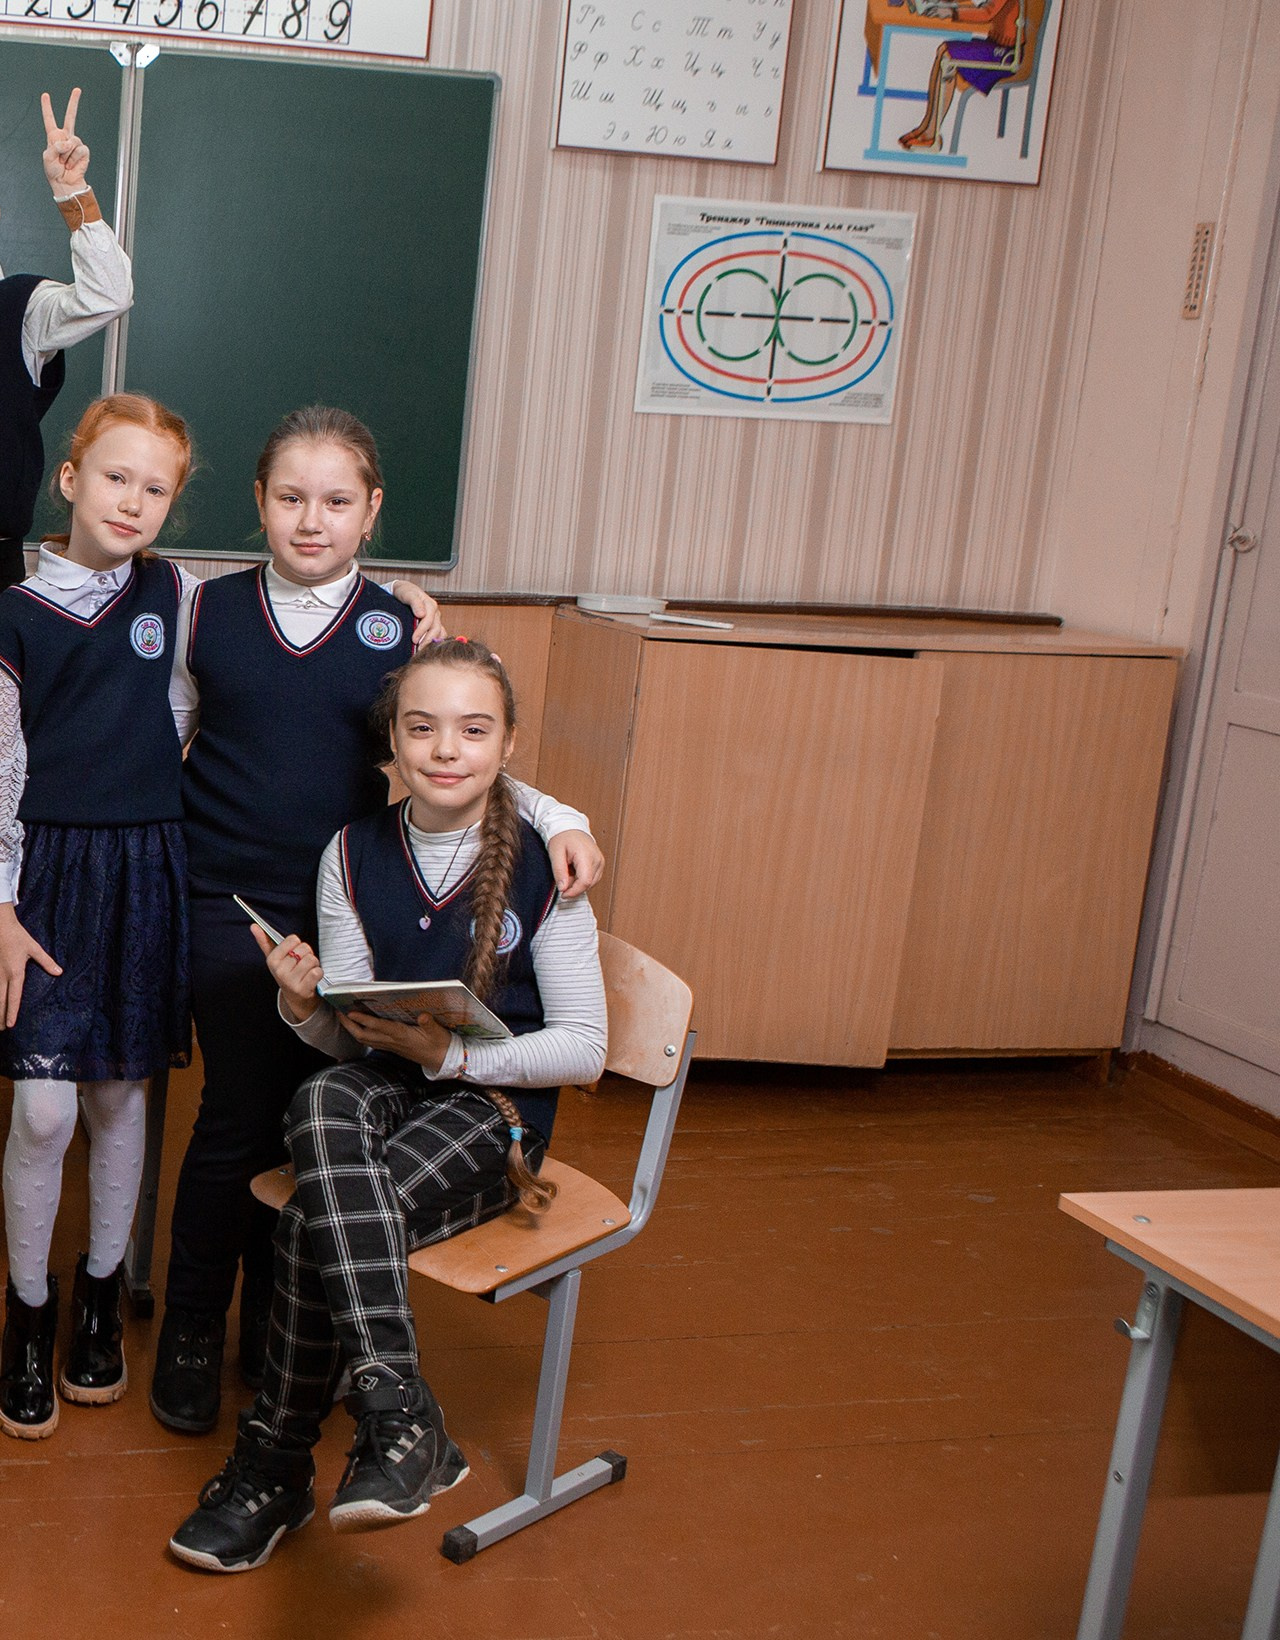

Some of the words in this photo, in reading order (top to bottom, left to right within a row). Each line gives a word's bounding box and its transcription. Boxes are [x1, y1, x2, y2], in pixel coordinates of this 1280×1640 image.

[197, 0, 219, 31] 6
[243, 0, 265, 35] 7
[282, 0, 308, 39] 8
[324, 0, 351, 40] 9
[700, 212, 751, 226] Тренажер
